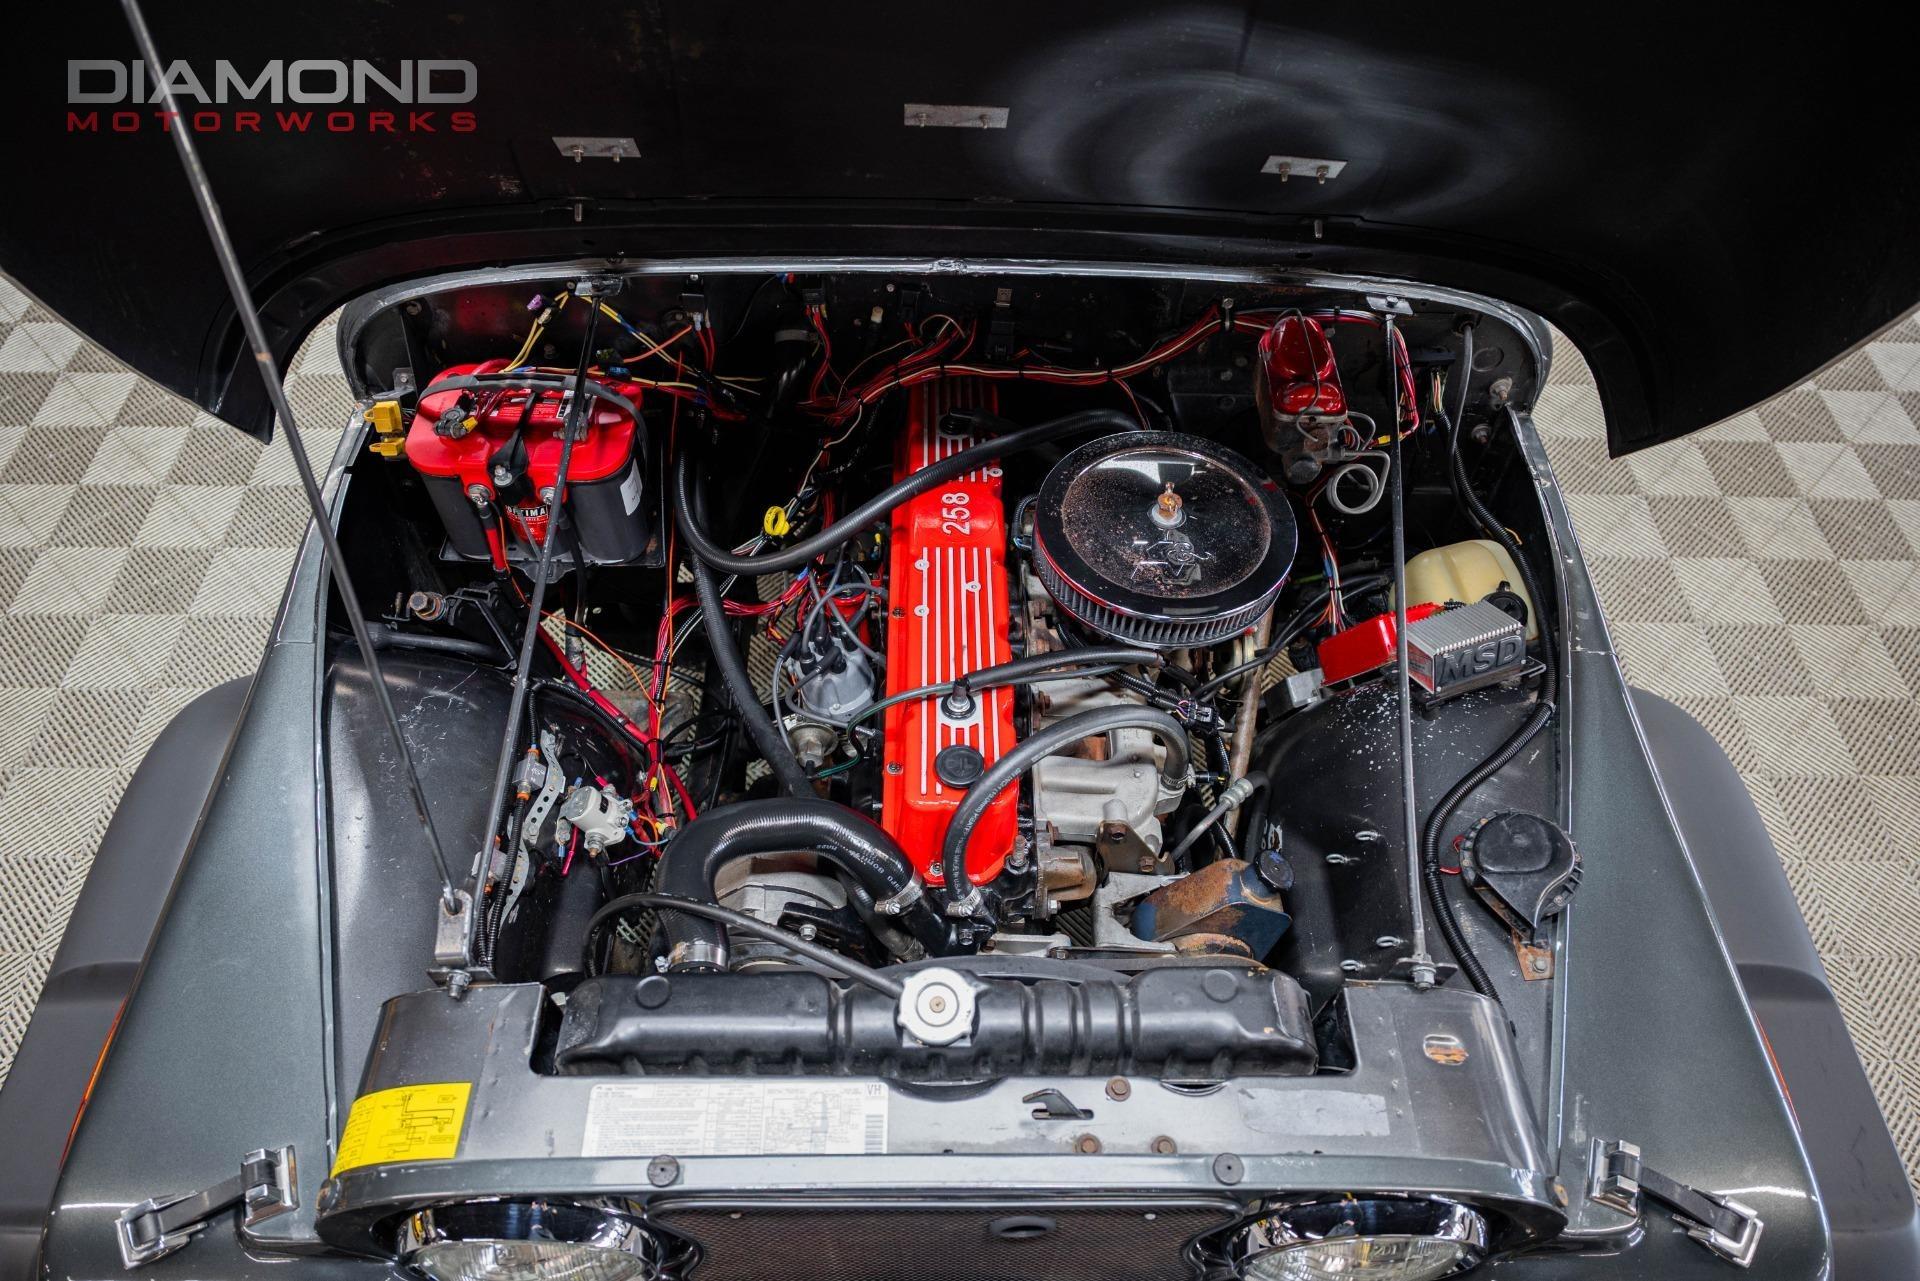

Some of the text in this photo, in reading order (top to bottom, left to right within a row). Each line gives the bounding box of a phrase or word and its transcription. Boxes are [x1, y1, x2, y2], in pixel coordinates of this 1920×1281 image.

[941, 492, 971, 536] 258
[1437, 635, 1522, 686] MSD
[867, 1083, 881, 1096] VH
